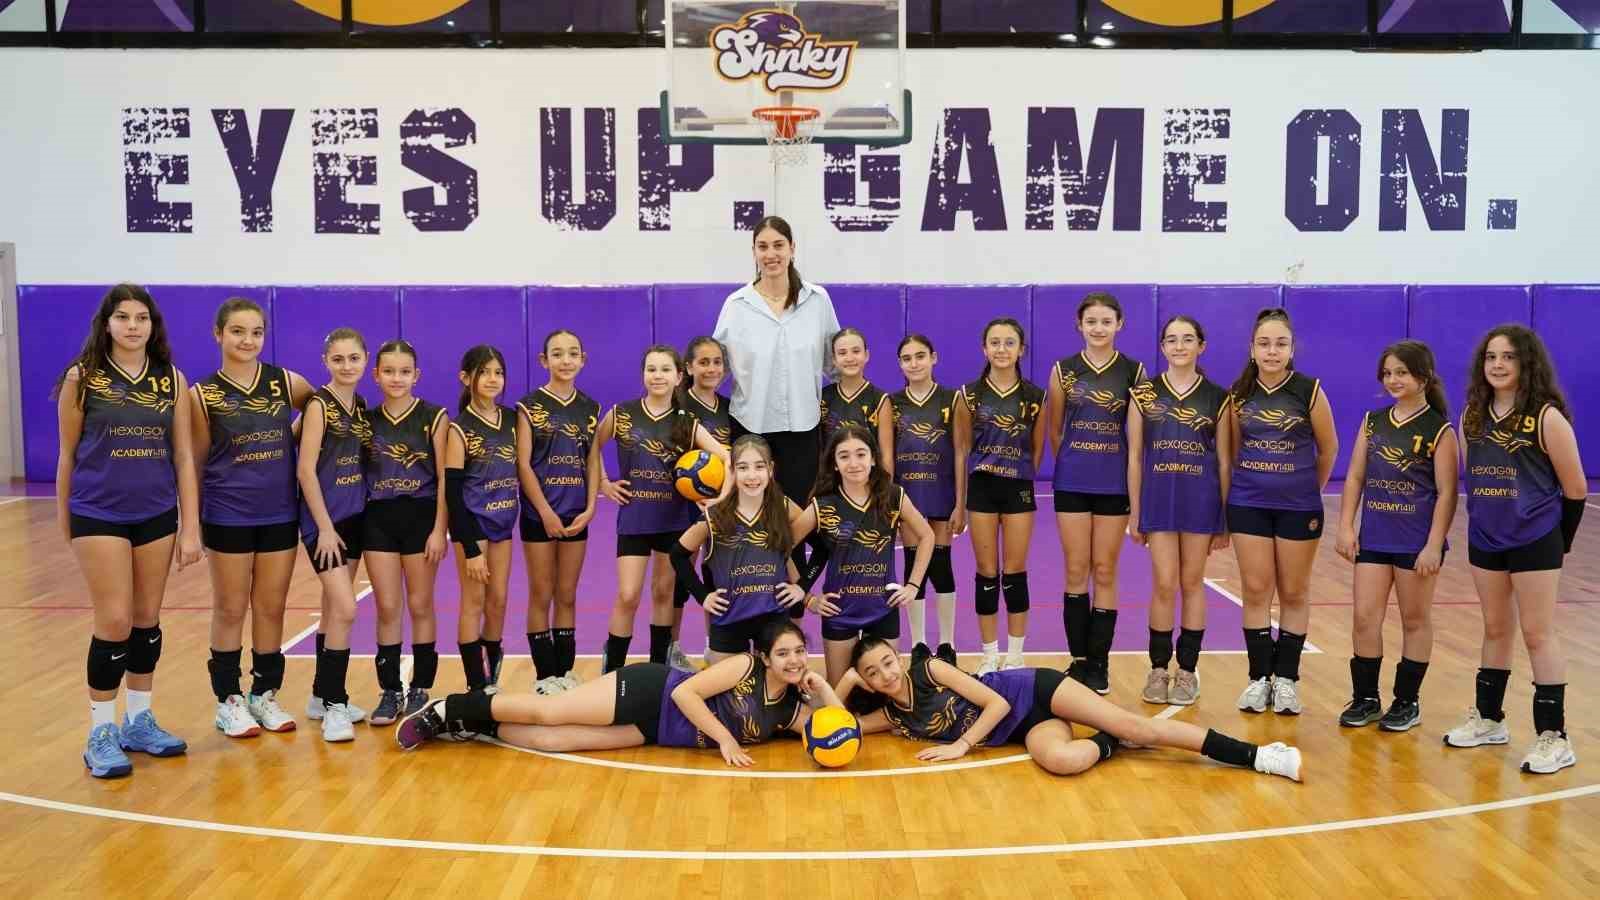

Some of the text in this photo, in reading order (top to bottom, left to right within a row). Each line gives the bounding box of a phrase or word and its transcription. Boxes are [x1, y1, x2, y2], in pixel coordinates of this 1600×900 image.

[122, 106, 1518, 235] EYES UP. GAME ON.
[147, 376, 171, 393] 18
[270, 380, 281, 397] 5
